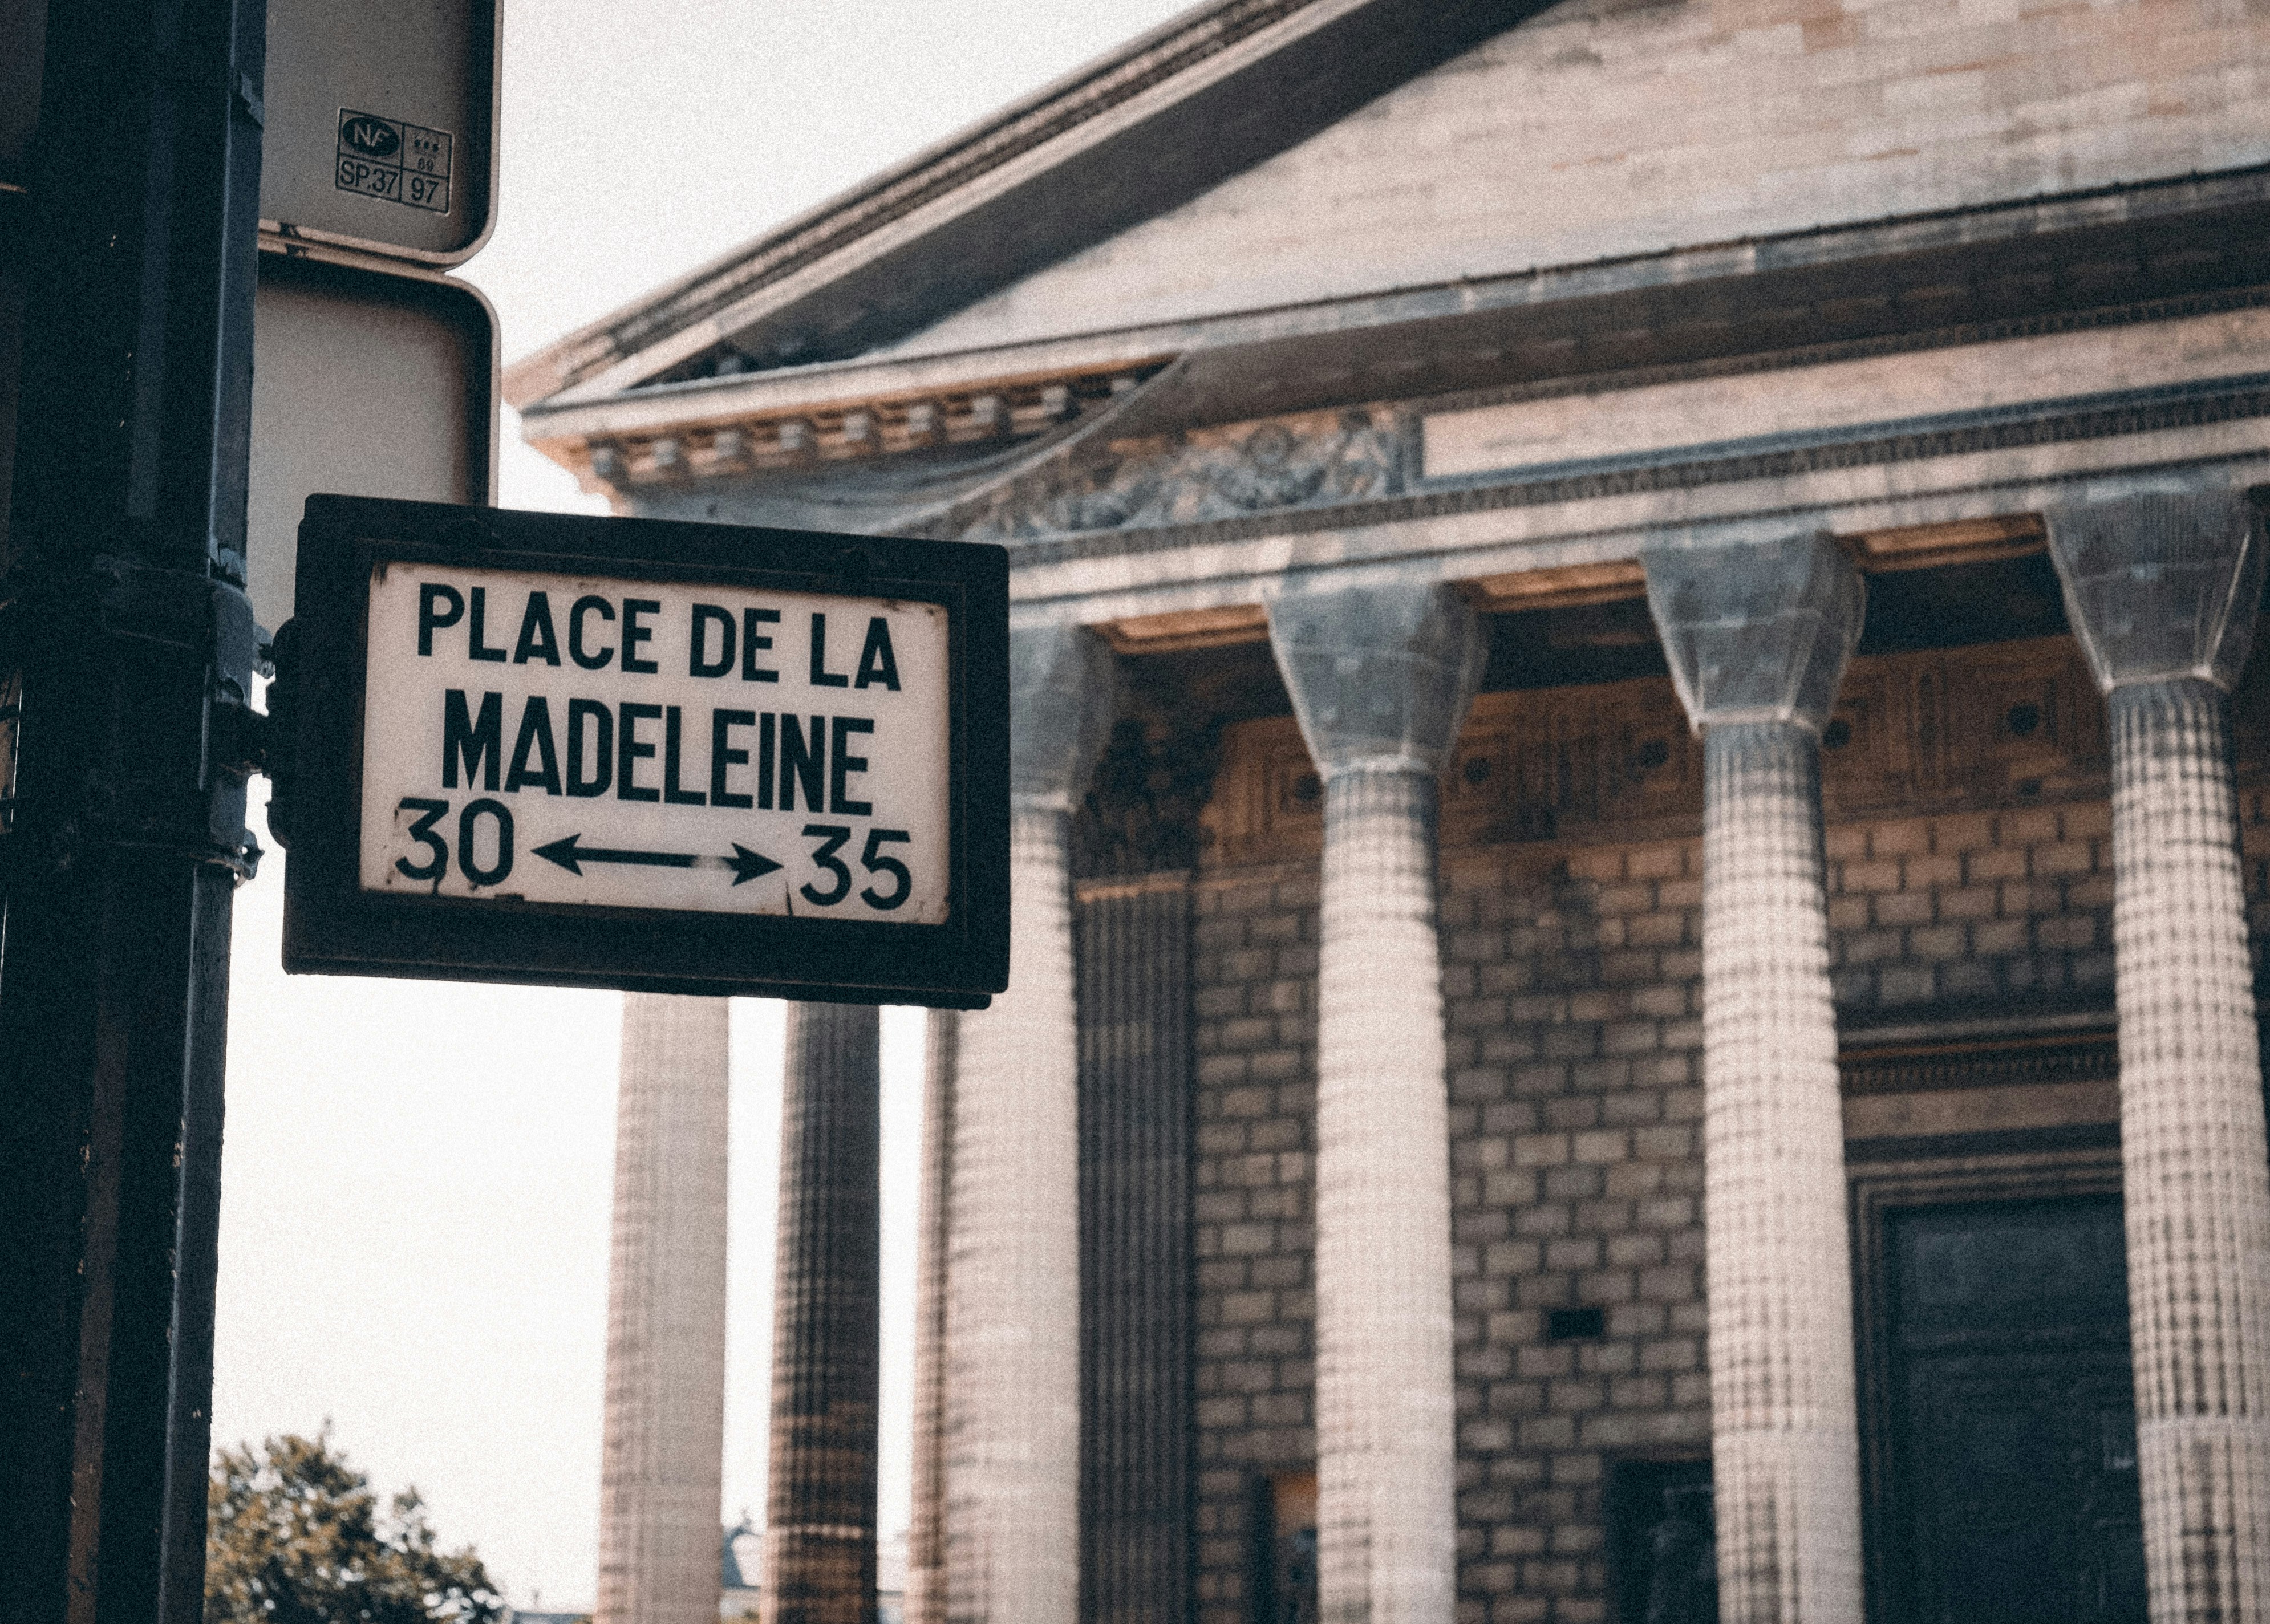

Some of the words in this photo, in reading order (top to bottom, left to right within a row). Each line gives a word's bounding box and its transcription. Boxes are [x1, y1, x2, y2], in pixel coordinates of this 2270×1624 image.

[353, 123, 389, 147] NF
[340, 160, 399, 194] SP.37
[411, 177, 440, 204] 97
[417, 582, 661, 675] PLACE
[689, 602, 781, 684] DE
[810, 611, 902, 692] LA
[442, 689, 875, 817] MADELEINE
[395, 798, 514, 886] 30
[800, 823, 913, 912] 35
